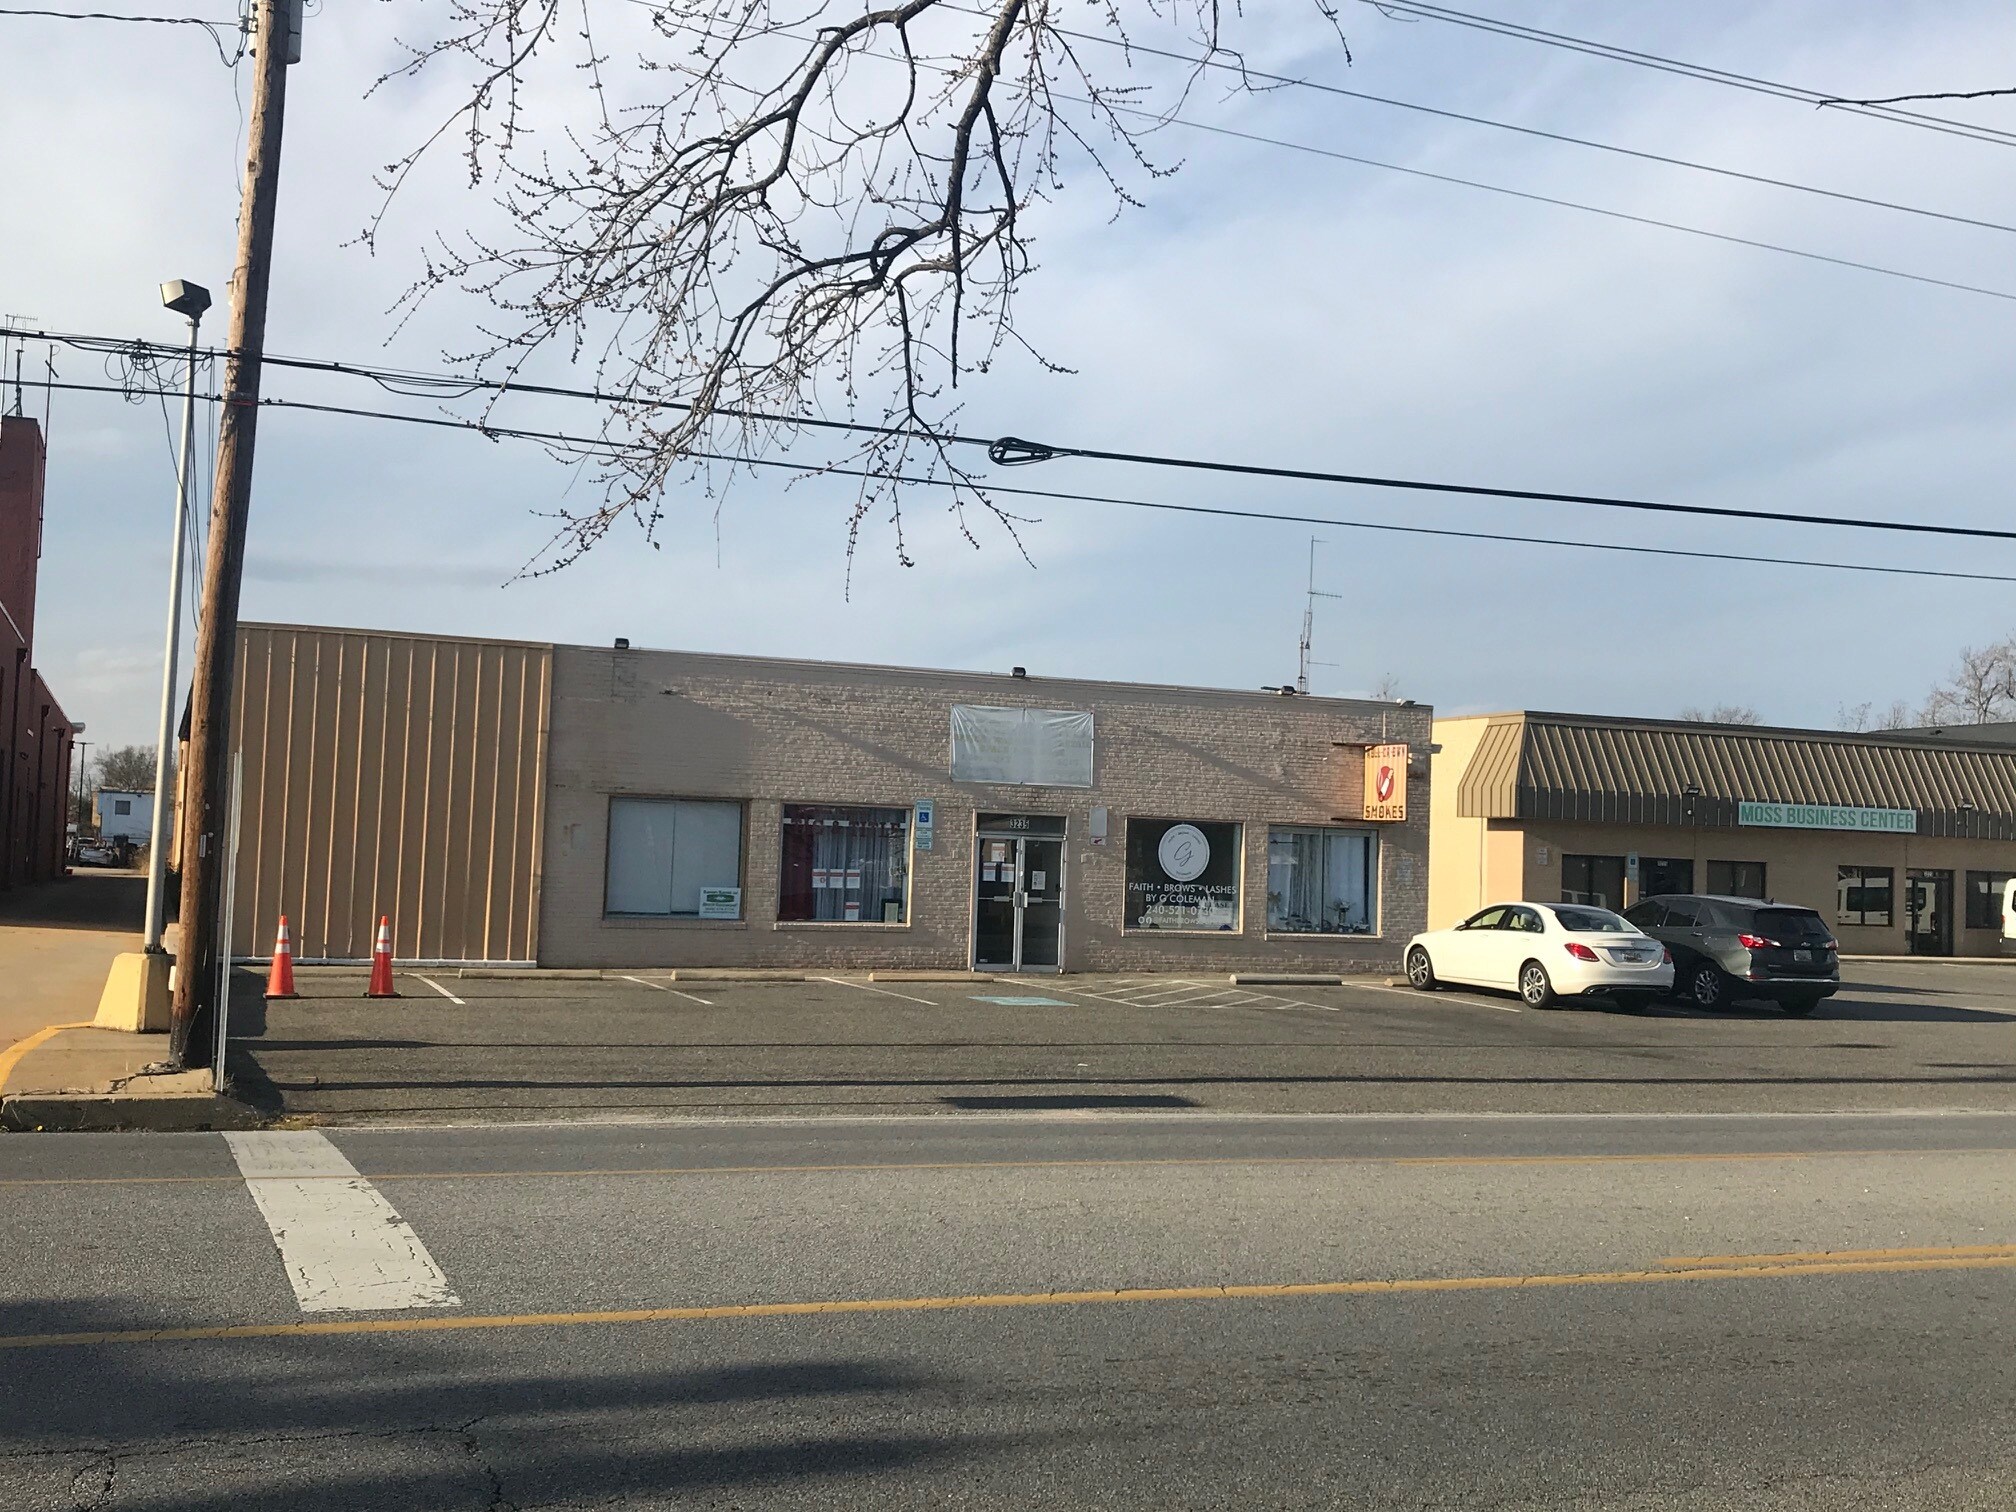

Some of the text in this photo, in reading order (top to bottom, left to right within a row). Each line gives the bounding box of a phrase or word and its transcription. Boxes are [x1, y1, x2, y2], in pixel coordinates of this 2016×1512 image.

[1365, 805, 1404, 819] SMOKES
[1740, 804, 1914, 830] MOSS BUSINESS CENTER
[1128, 882, 1237, 895] FAITH BROWS LASHES
[1145, 893, 1215, 905] BY G COLEMAN
